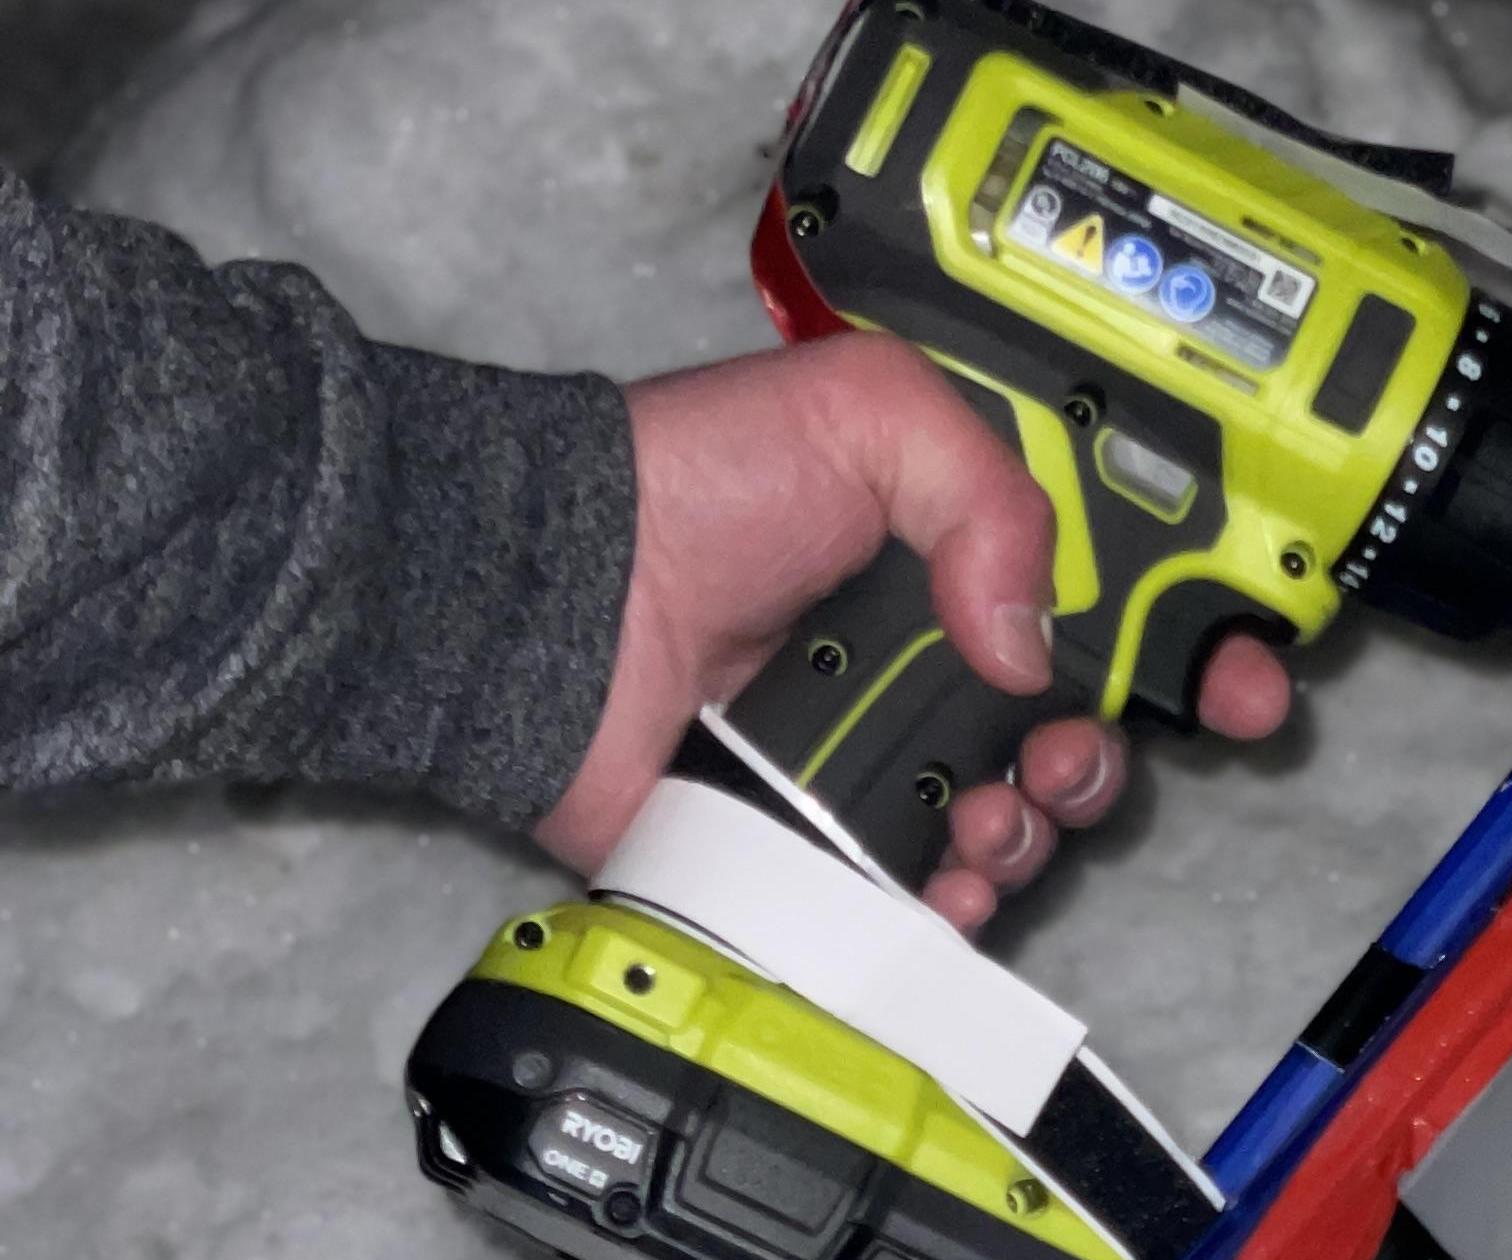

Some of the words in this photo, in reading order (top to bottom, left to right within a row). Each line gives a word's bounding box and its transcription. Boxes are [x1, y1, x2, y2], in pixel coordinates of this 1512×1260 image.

[1457, 354, 1481, 381] 8
[1413, 426, 1448, 472] 10
[1370, 503, 1406, 543] 12
[561, 1110, 643, 1165] RYOBI
